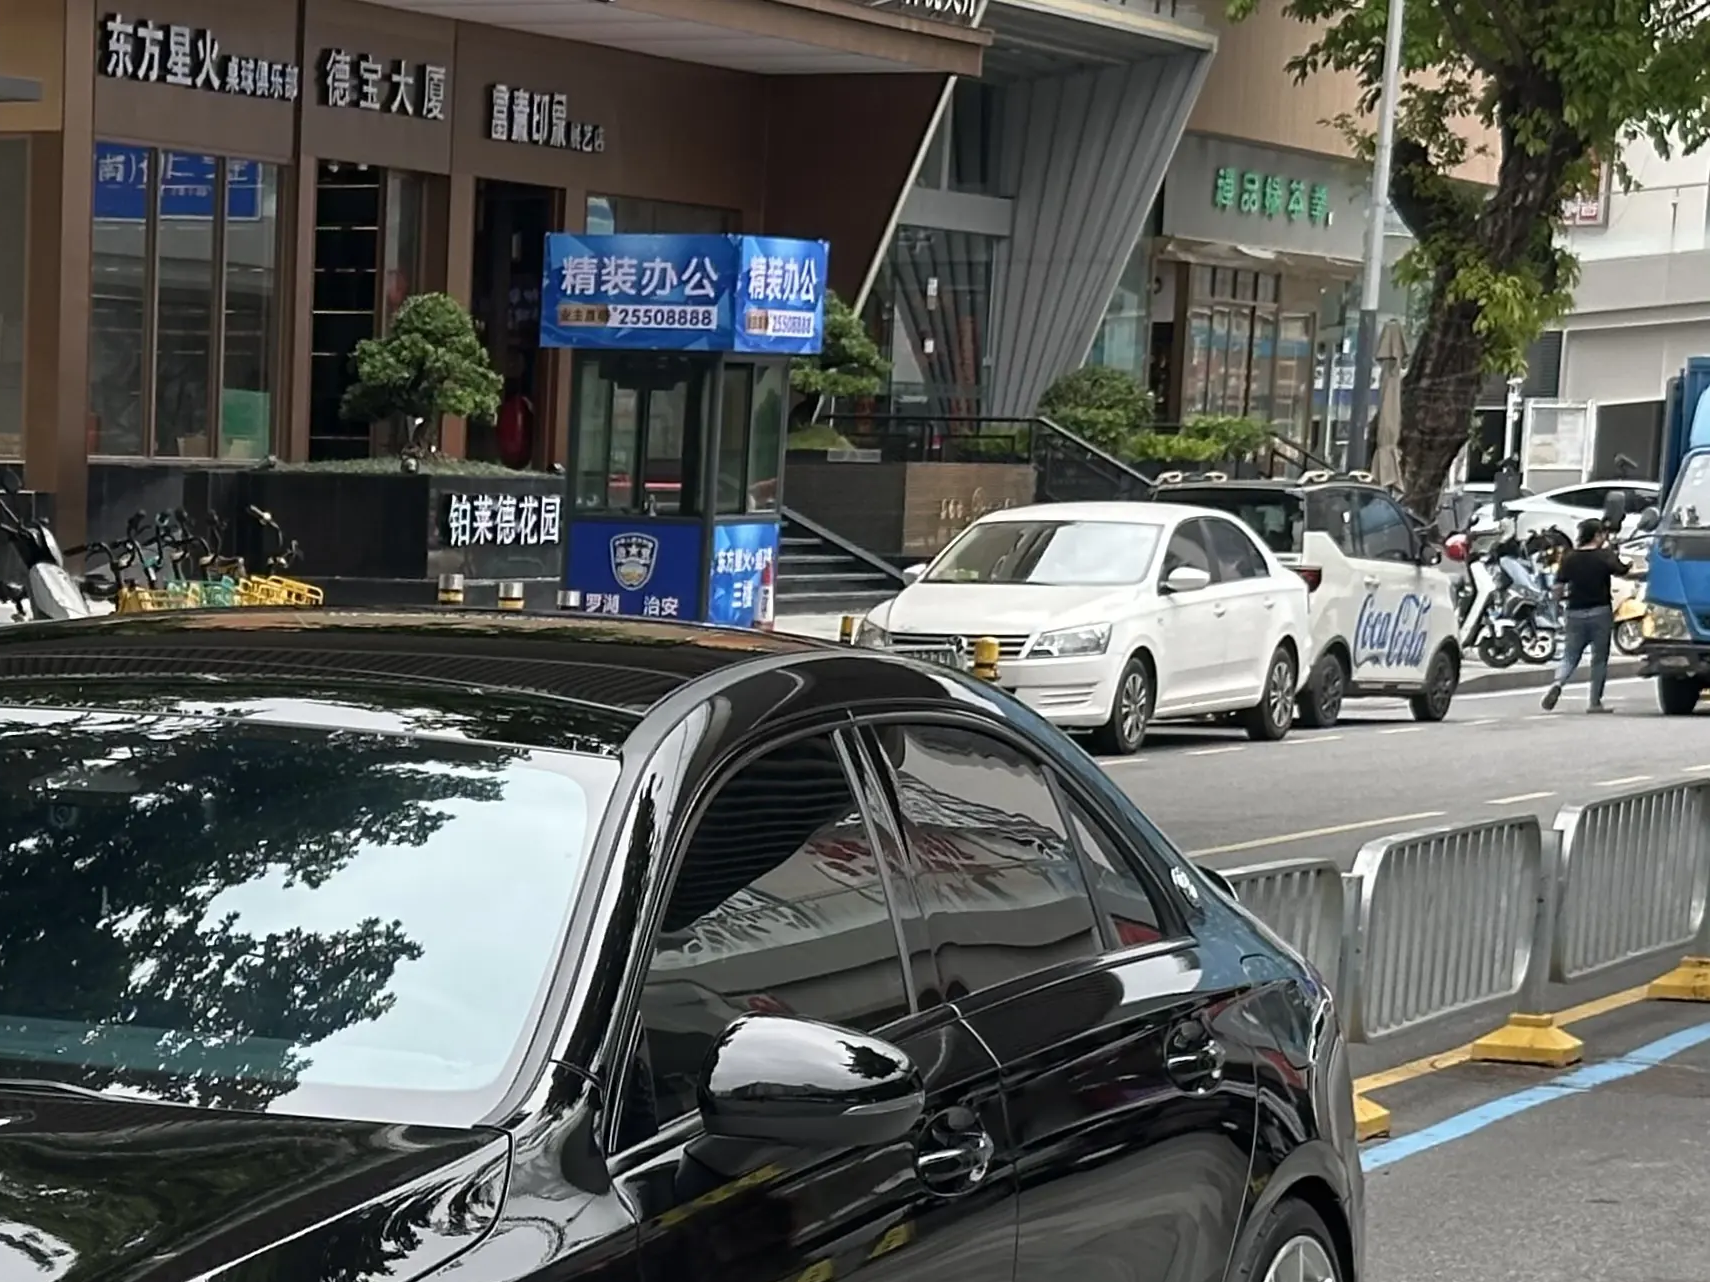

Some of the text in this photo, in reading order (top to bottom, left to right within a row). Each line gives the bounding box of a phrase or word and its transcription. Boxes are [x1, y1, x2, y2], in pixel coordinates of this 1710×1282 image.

[106, 14, 220, 91] 东方星火
[326, 49, 445, 121] 德宝大厦
[561, 256, 718, 298] 精装办公
[748, 255, 816, 303] 精装办公
[619, 308, 712, 326] 25508888
[449, 494, 561, 546] 铂莱德花园
[585, 592, 679, 616] 罗湖 治安
[1354, 593, 1431, 668] Coca Cola
